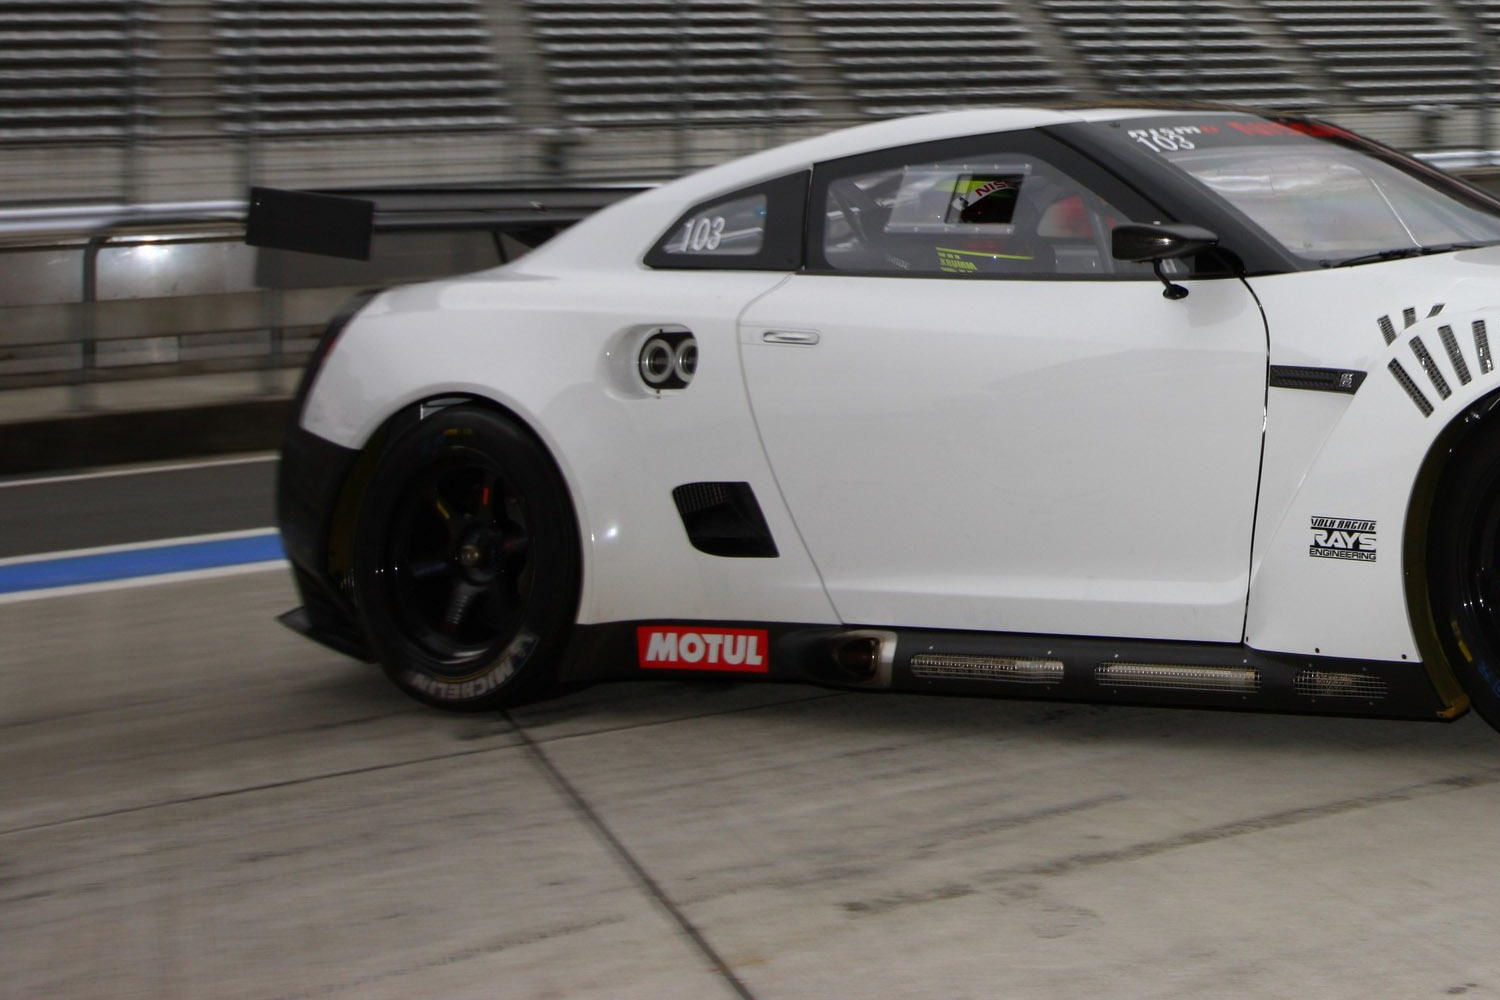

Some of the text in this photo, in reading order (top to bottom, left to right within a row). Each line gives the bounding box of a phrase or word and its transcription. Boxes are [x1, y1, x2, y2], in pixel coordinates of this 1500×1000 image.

[1136, 132, 1196, 153] 103
[680, 216, 725, 252] 103
[1311, 518, 1377, 531] VOLK RACING
[1310, 528, 1377, 551] RAYS
[1309, 548, 1377, 560] ENGINEERING
[646, 632, 764, 666] MOTUL
[407, 655, 516, 700] MICHELIN
